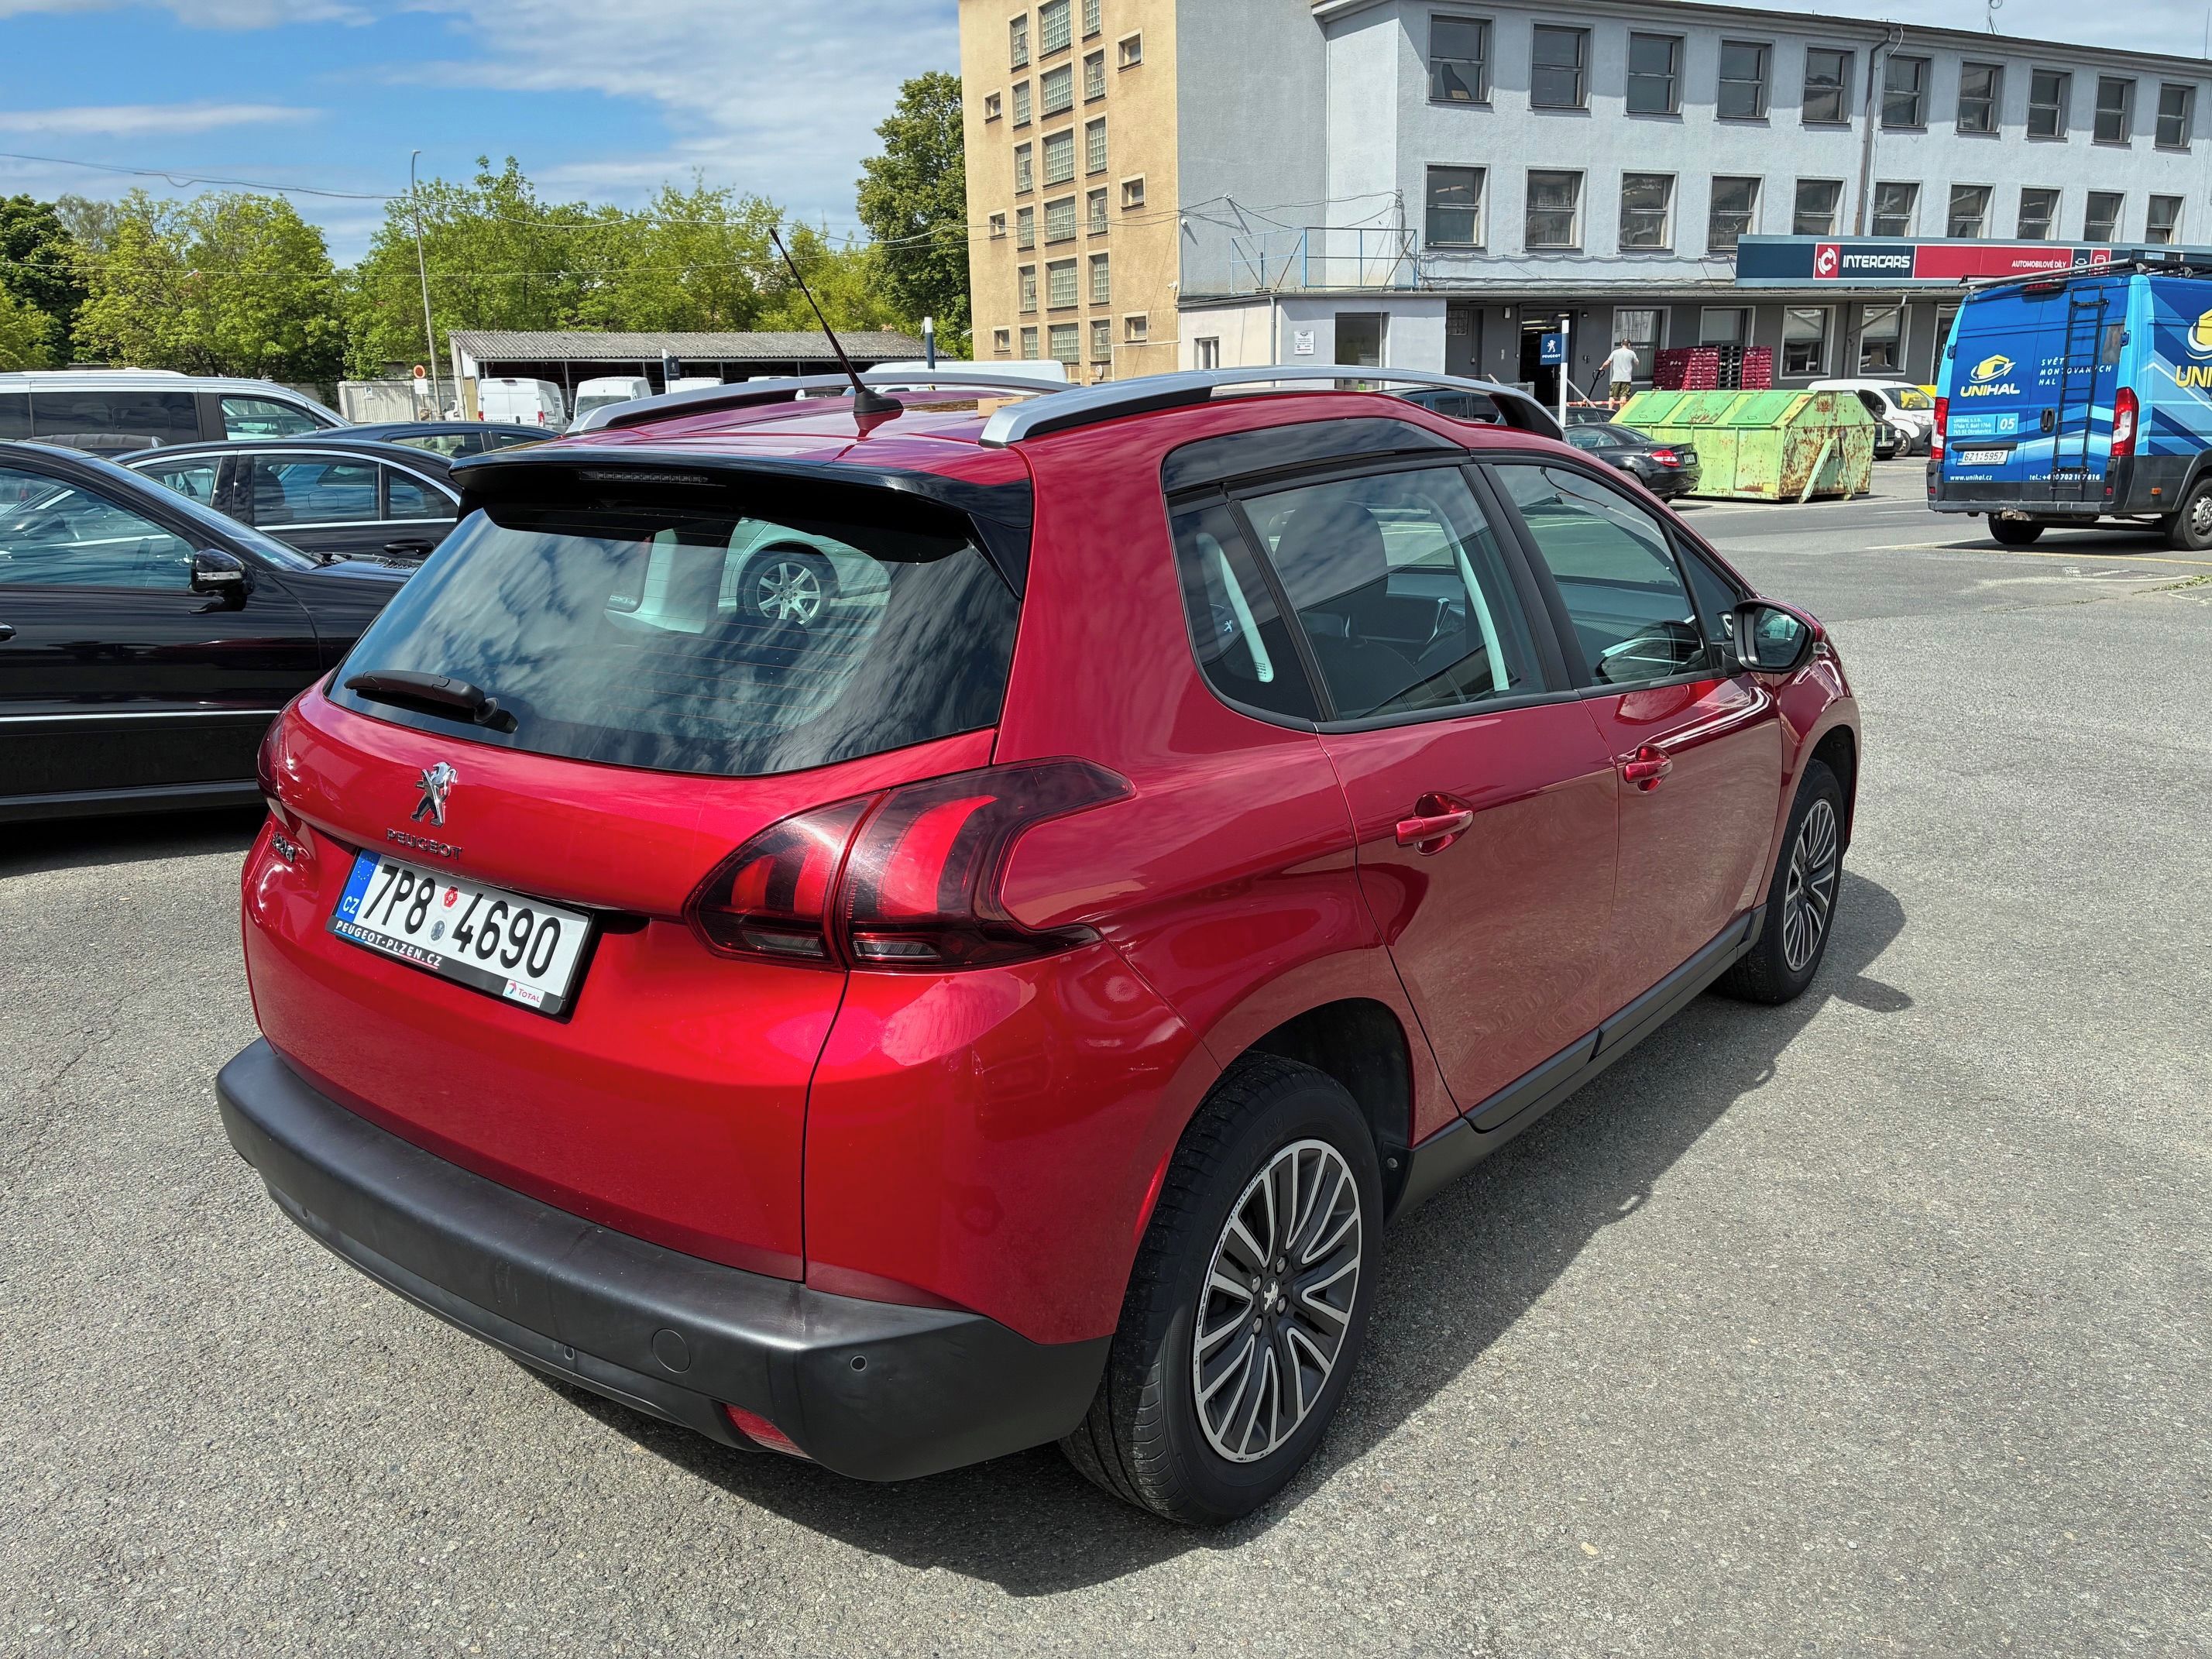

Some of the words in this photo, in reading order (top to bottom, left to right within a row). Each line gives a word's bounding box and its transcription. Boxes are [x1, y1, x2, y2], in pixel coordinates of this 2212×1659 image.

[1843, 255, 1911, 269] INTERCARS
[2011, 259, 2054, 269] AUTOMOBILOVÉ
[2054, 259, 2067, 269] DÍLY
[2039, 365, 2112, 376] MONOVANCH
[1960, 383, 2021, 397] UNIHAL
[2000, 417, 2016, 431] 05
[1964, 452, 1979, 461] 6Z1
[1984, 452, 2004, 461] 5957
[386, 828, 463, 860] PEUGEOT
[342, 895, 360, 915] CZ
[362, 864, 436, 935] 7P8
[452, 892, 562, 979] 4690
[335, 920, 443, 967] PEUGEOT-PLZEN.CZ
[518, 988, 541, 1003] TOTAL
